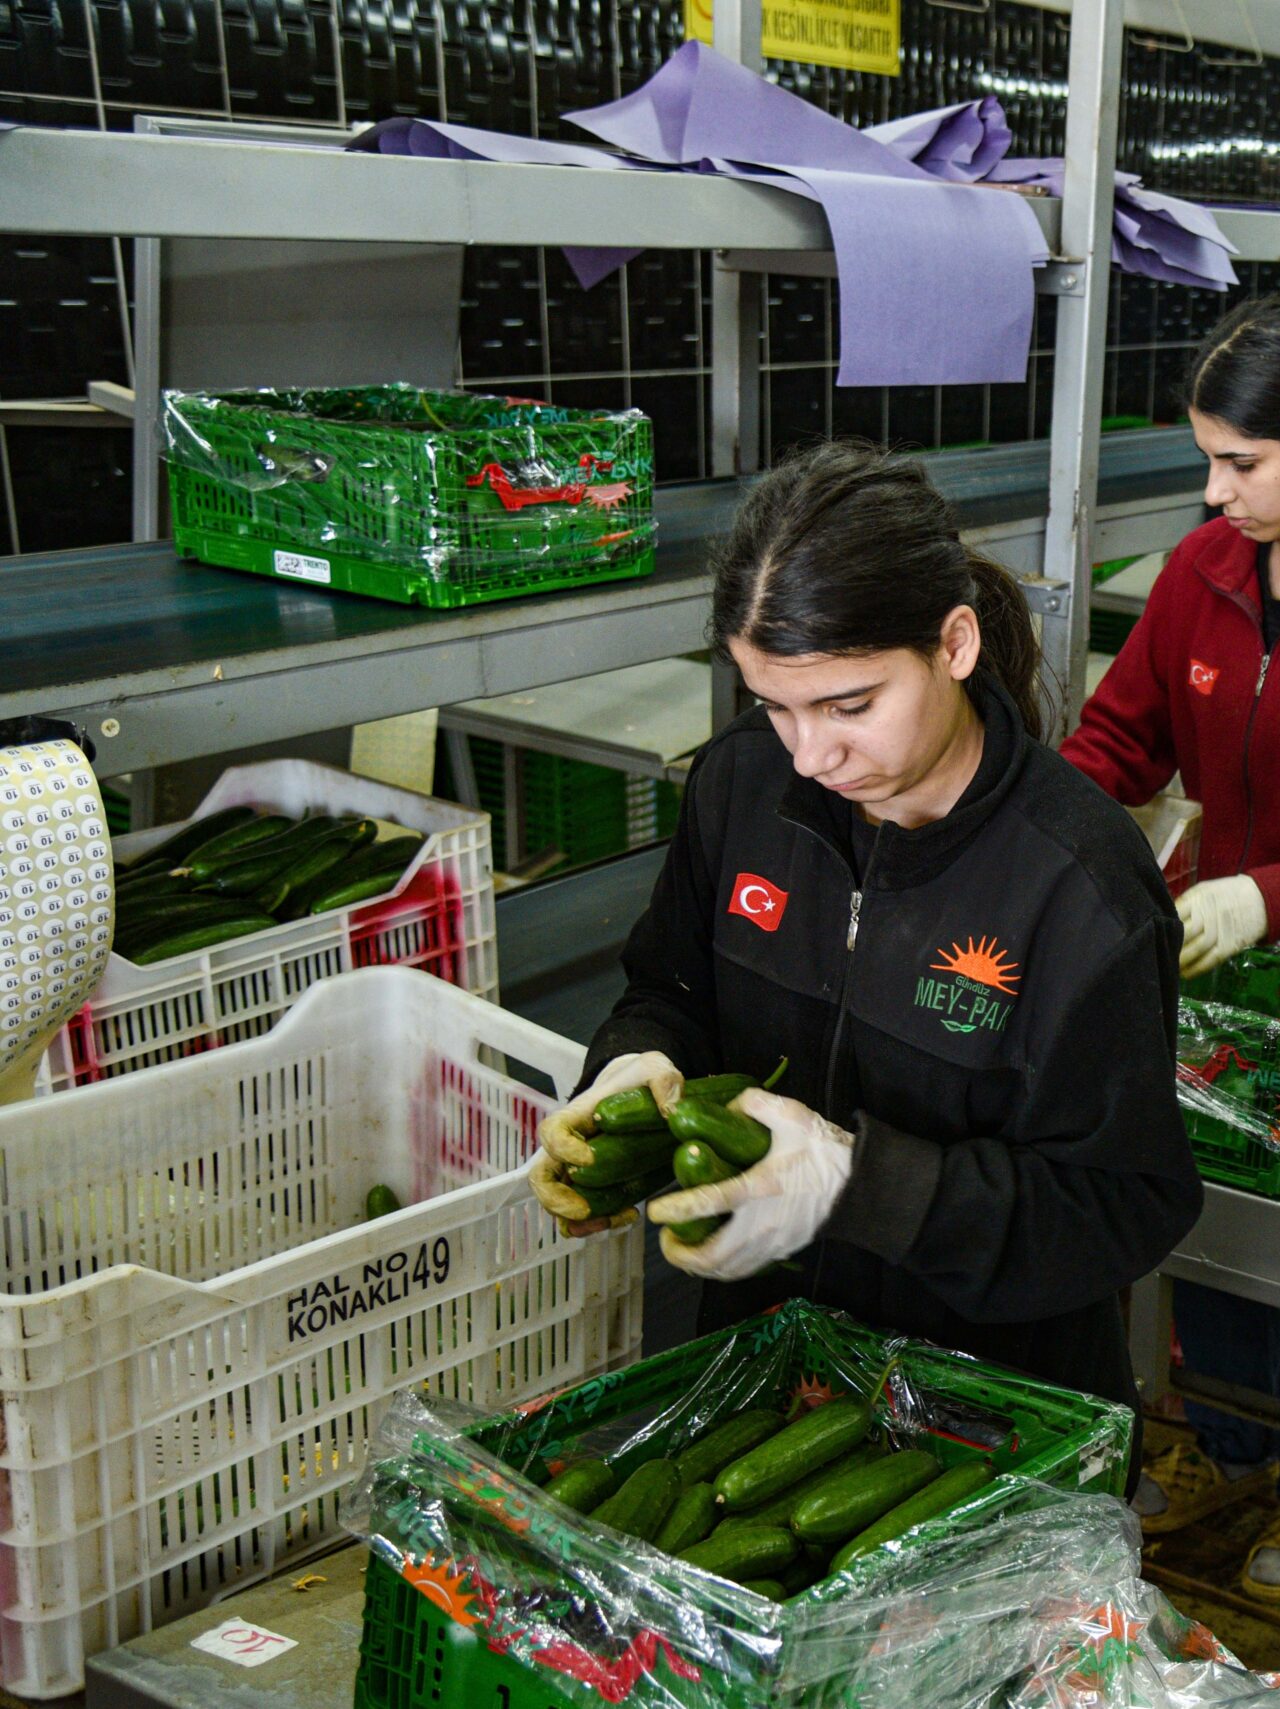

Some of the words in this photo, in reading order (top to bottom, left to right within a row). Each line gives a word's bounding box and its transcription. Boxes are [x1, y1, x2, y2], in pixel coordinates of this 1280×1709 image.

[955, 975, 992, 997] Gündüz
[288, 1275, 350, 1313] HAL
[363, 1252, 408, 1284] NO
[288, 1271, 409, 1343] KONAKLI
[413, 1236, 451, 1290] 49
